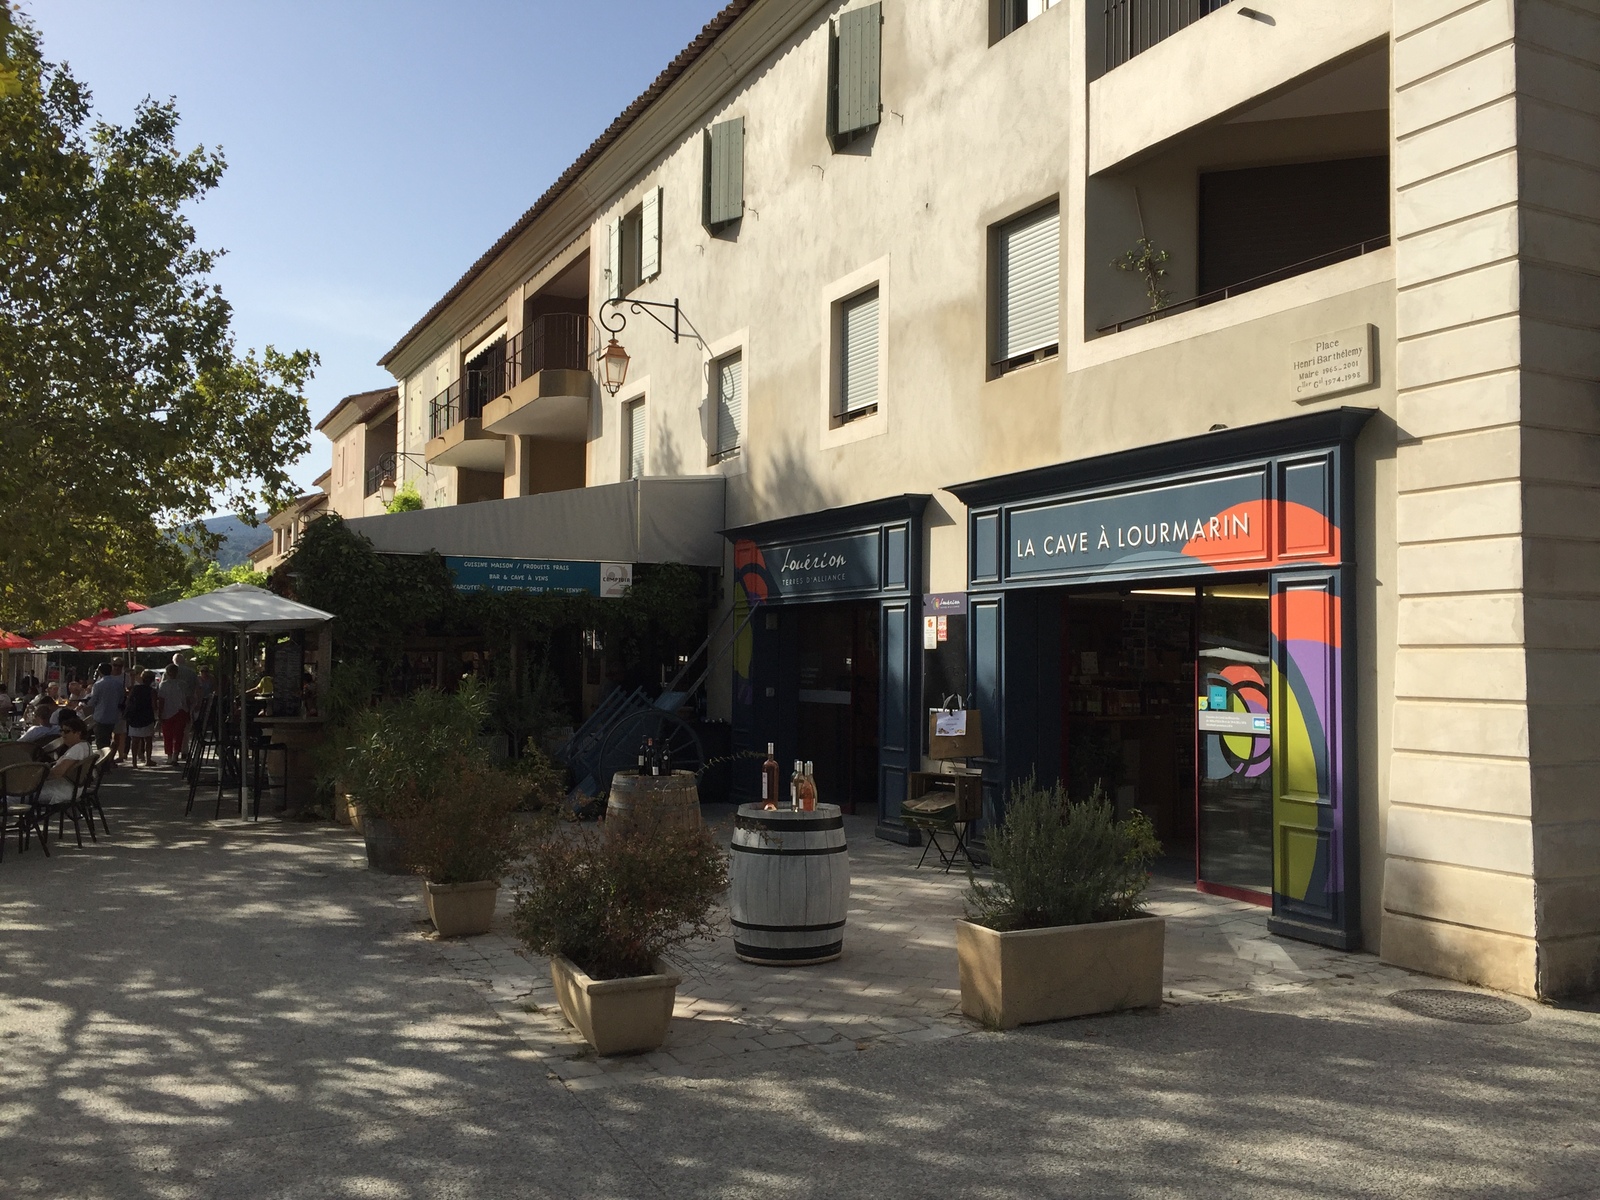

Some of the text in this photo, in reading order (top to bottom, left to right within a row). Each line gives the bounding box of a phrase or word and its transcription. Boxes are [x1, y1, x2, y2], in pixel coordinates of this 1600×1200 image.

[1316, 340, 1340, 352] Place
[1293, 346, 1363, 370] Henri Barthélemy
[1299, 369, 1319, 380] Maire
[1017, 512, 1250, 558] LA CAVE À LOURMARIN
[781, 548, 847, 573] Louérion
[782, 573, 846, 586] TERRES D'ALLIANCE
